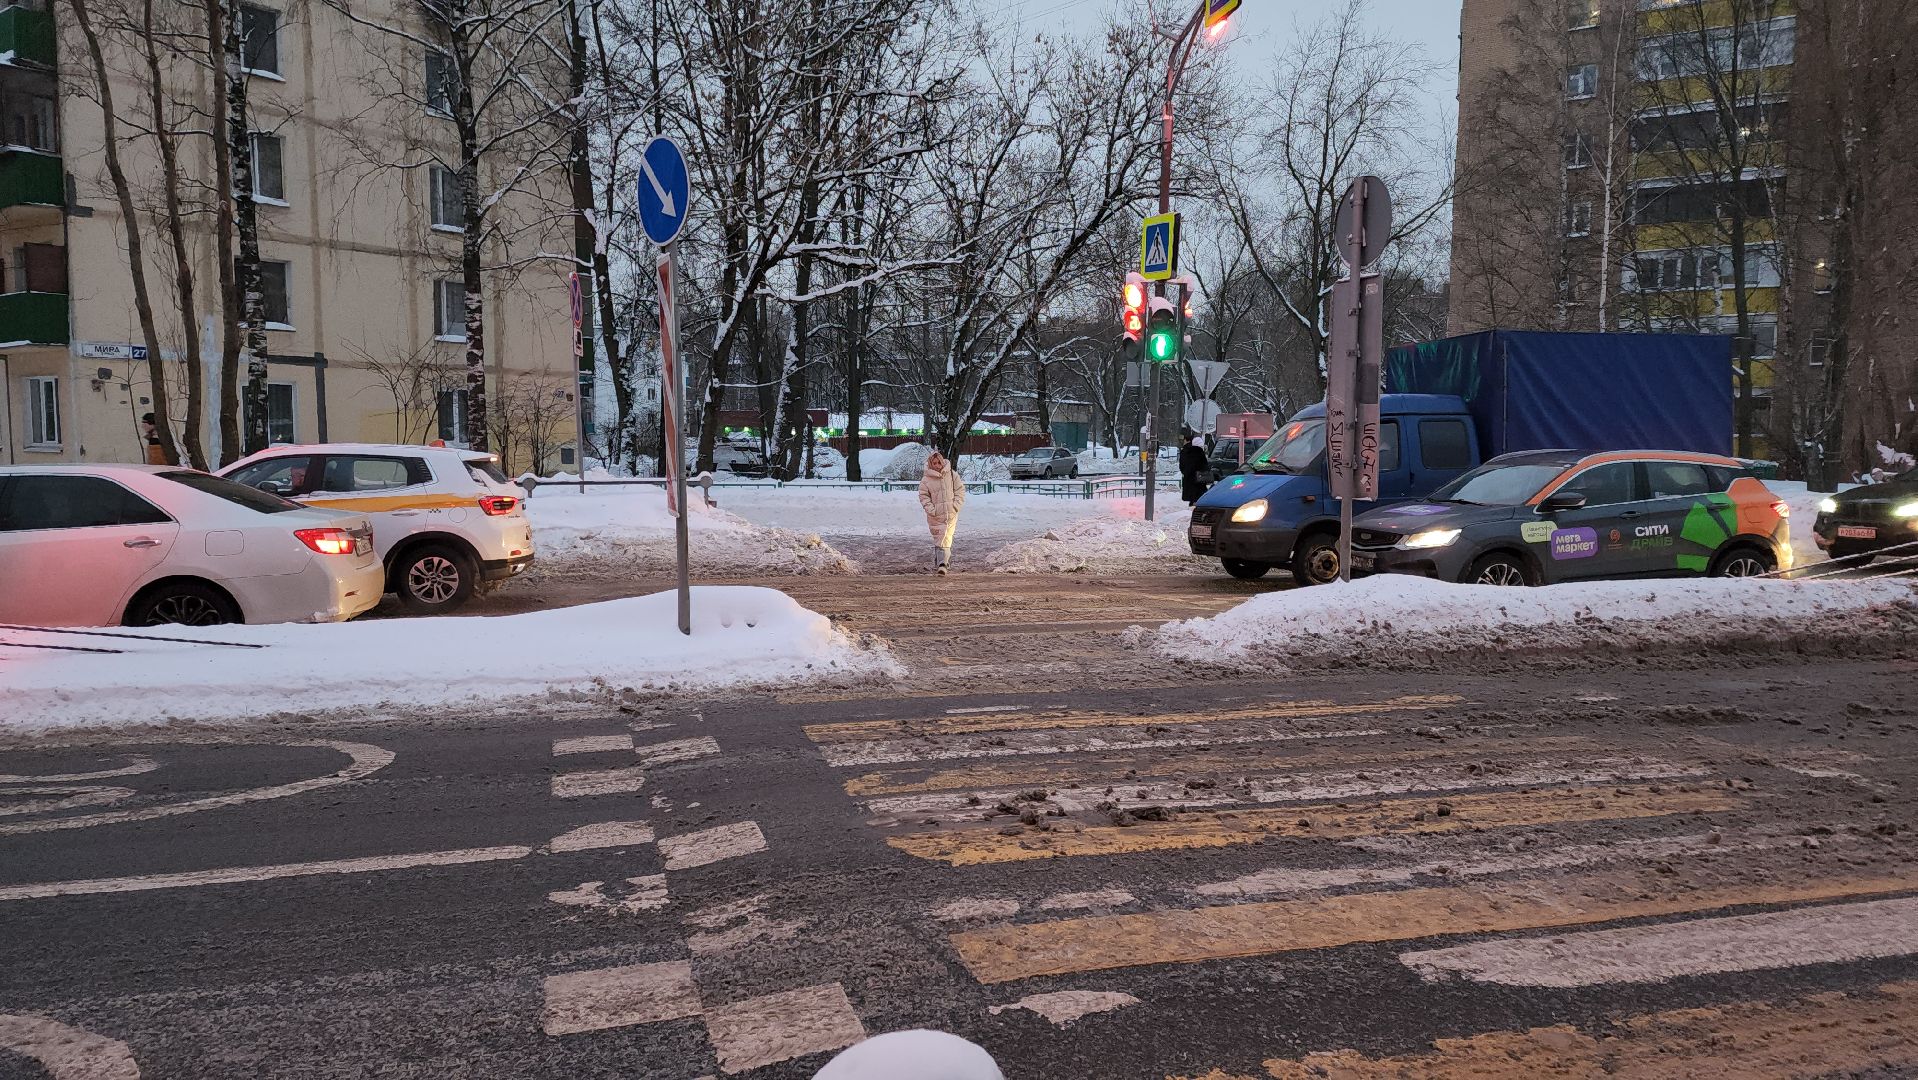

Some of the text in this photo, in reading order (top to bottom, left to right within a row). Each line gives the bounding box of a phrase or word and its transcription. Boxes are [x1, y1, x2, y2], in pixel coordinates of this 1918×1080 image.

[95, 345, 120, 353] МИРА
[133, 349, 145, 358] 27
[1635, 524, 1669, 537] СИТИ
[1556, 541, 1595, 554] маркет
